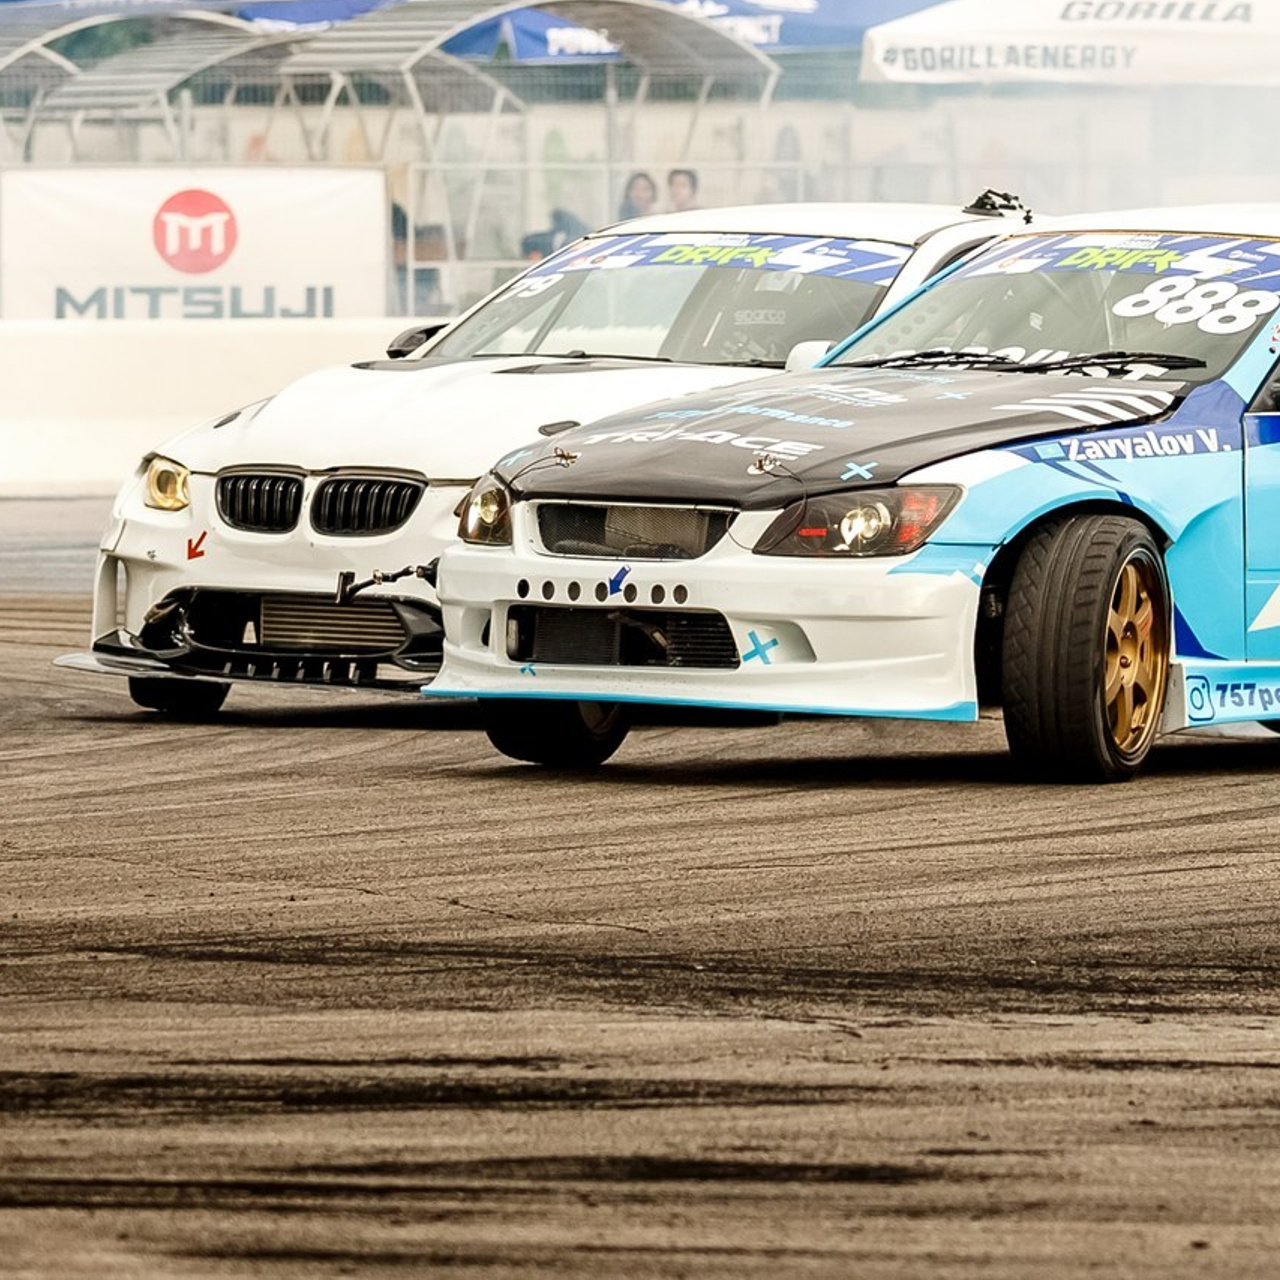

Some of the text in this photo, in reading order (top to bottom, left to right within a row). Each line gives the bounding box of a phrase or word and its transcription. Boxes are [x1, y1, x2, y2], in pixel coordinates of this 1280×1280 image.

[1060, 0, 1252, 23] GORILLA
[883, 44, 1138, 71] #GORILLAENERGY
[55, 285, 334, 320] MITSUJI
[583, 430, 825, 456] TRI-ACE
[1060, 428, 1231, 462] Zavyalov V.
